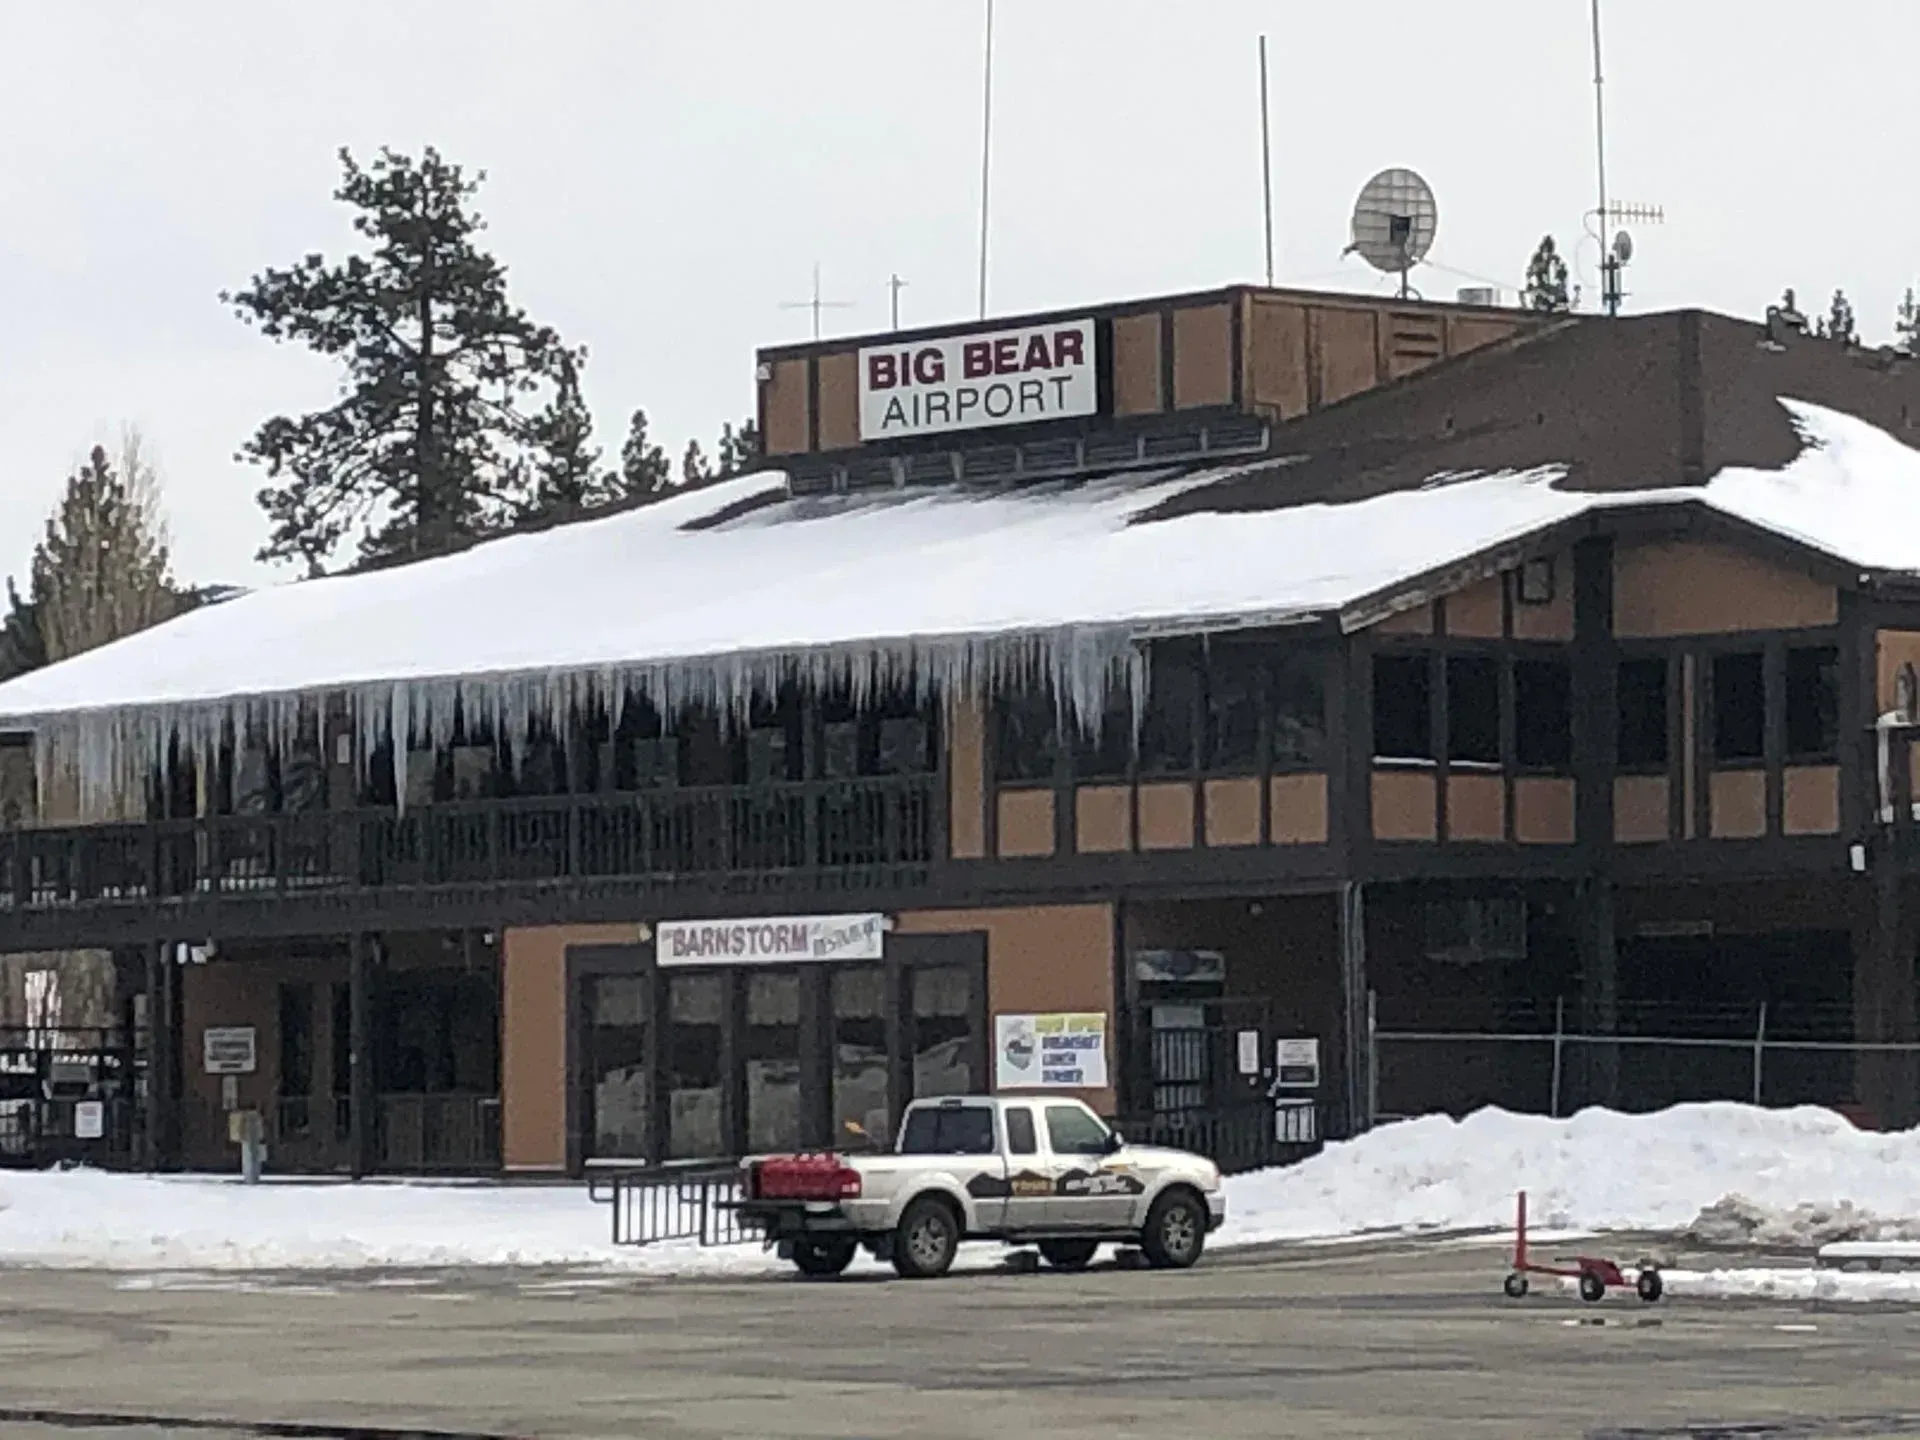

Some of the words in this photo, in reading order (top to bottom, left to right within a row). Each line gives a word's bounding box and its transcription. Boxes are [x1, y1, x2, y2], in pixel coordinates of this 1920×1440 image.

[868, 348, 945, 391] BIG
[963, 329, 1084, 379] BEAR
[881, 375, 1073, 429] AIRPORT
[672, 924, 809, 957] BARNSTORM
